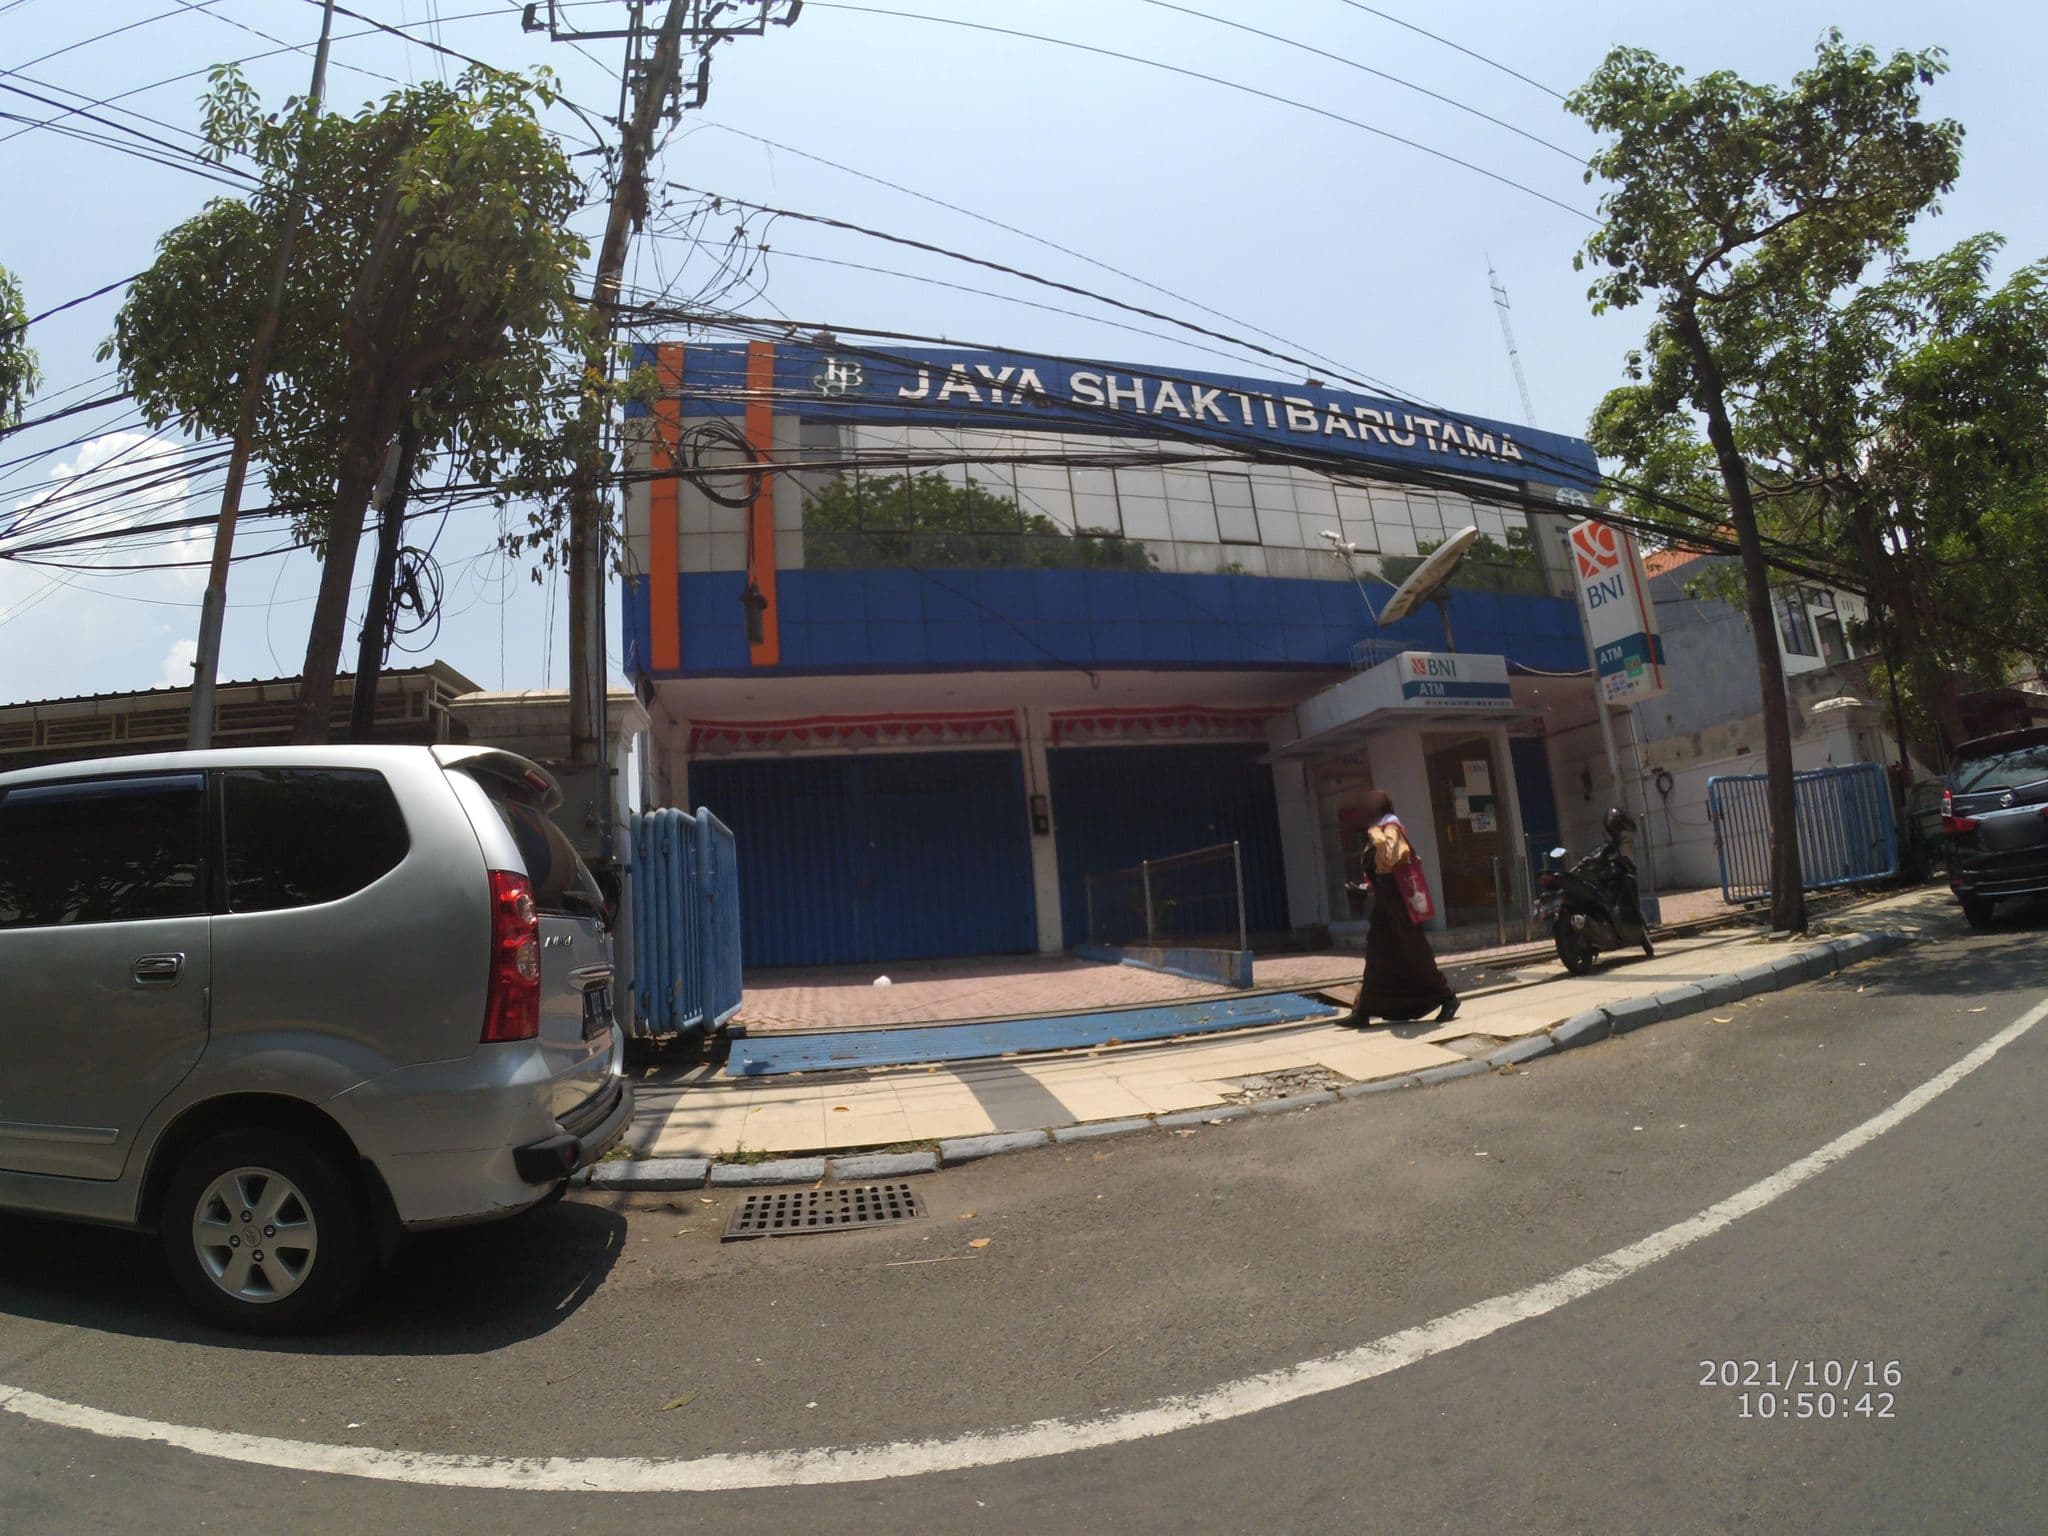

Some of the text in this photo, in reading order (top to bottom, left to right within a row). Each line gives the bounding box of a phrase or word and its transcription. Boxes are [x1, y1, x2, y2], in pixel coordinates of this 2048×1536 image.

[898, 361, 1048, 405] JAYA
[1587, 574, 1625, 609] BNI
[1600, 645, 1624, 665] ATM
[1427, 658, 1456, 677] BNI
[1420, 683, 1445, 696] ATM
